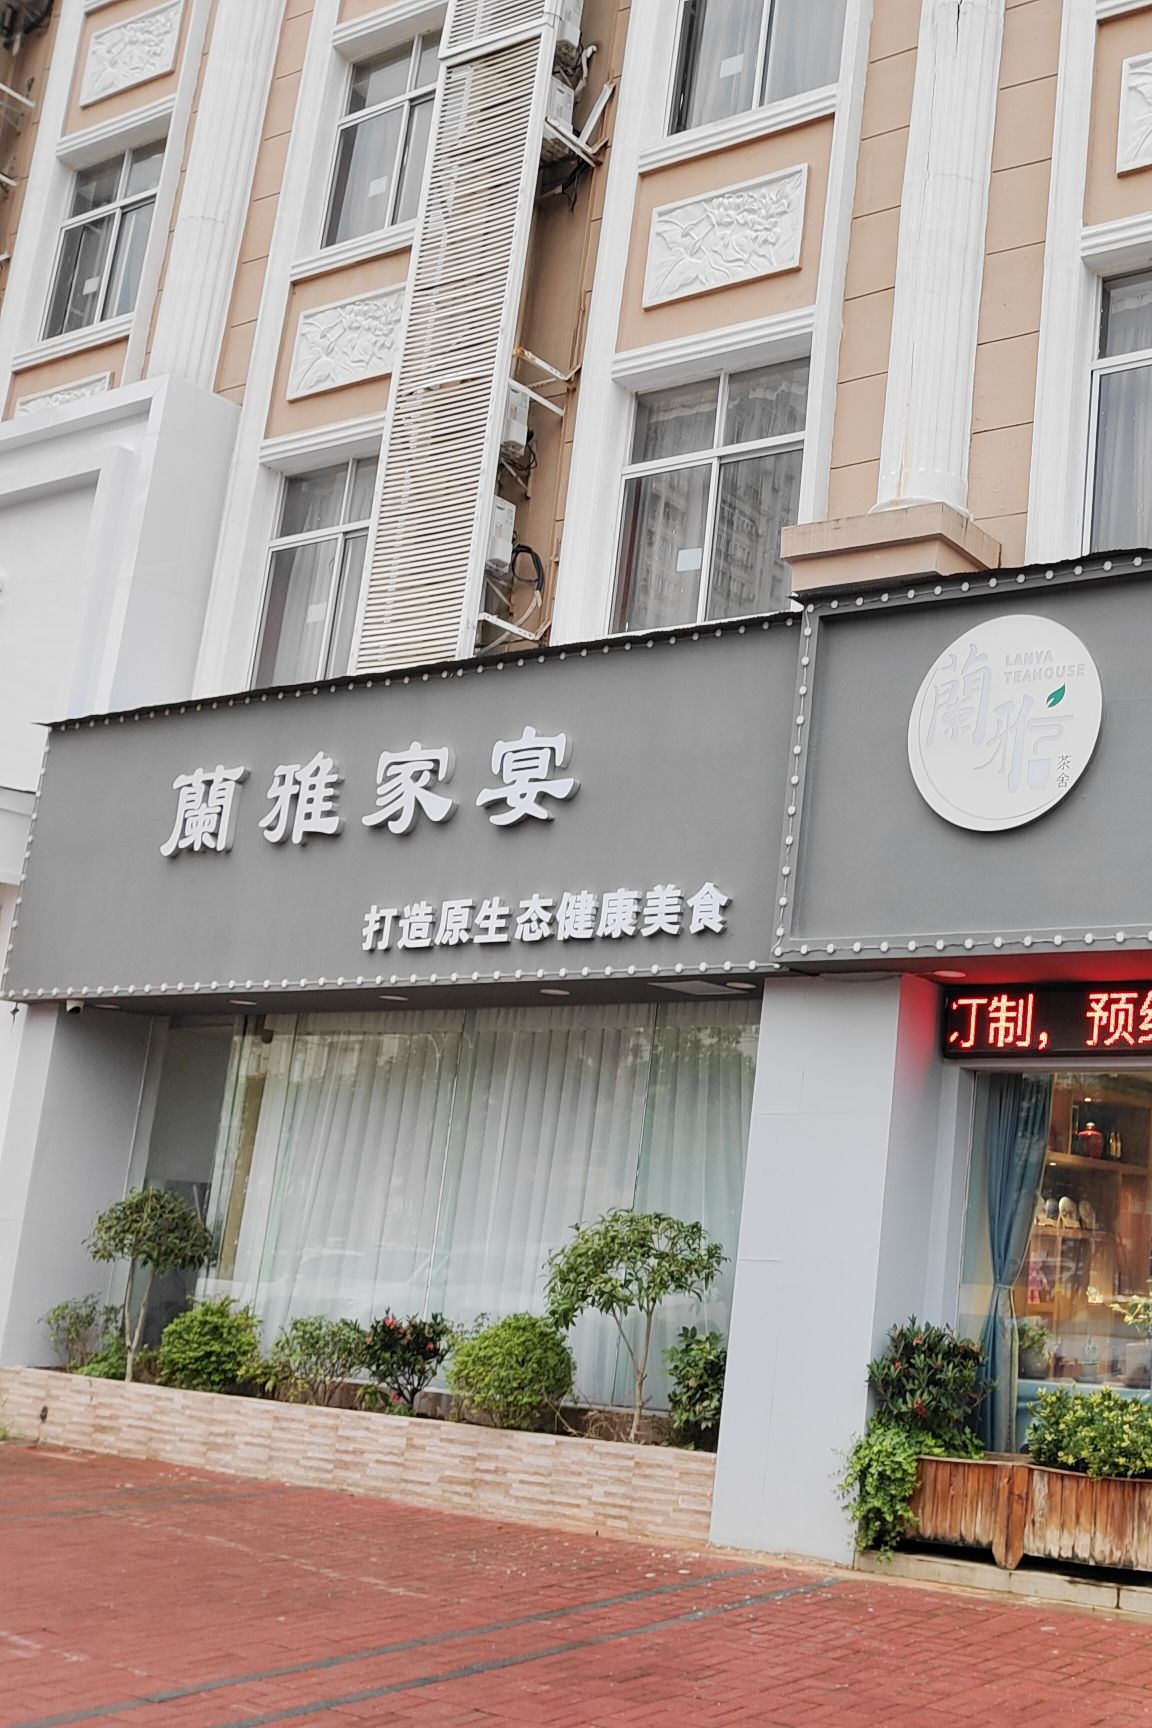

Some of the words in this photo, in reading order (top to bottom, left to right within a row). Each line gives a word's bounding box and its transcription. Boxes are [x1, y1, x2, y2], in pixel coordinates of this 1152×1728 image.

[1004, 649, 1053, 668] LANYA
[1004, 663, 1085, 685] TEAHOUSE
[159, 726, 581, 857] 蘭雅家宴
[361, 881, 729, 951] 打造原生态健康美食
